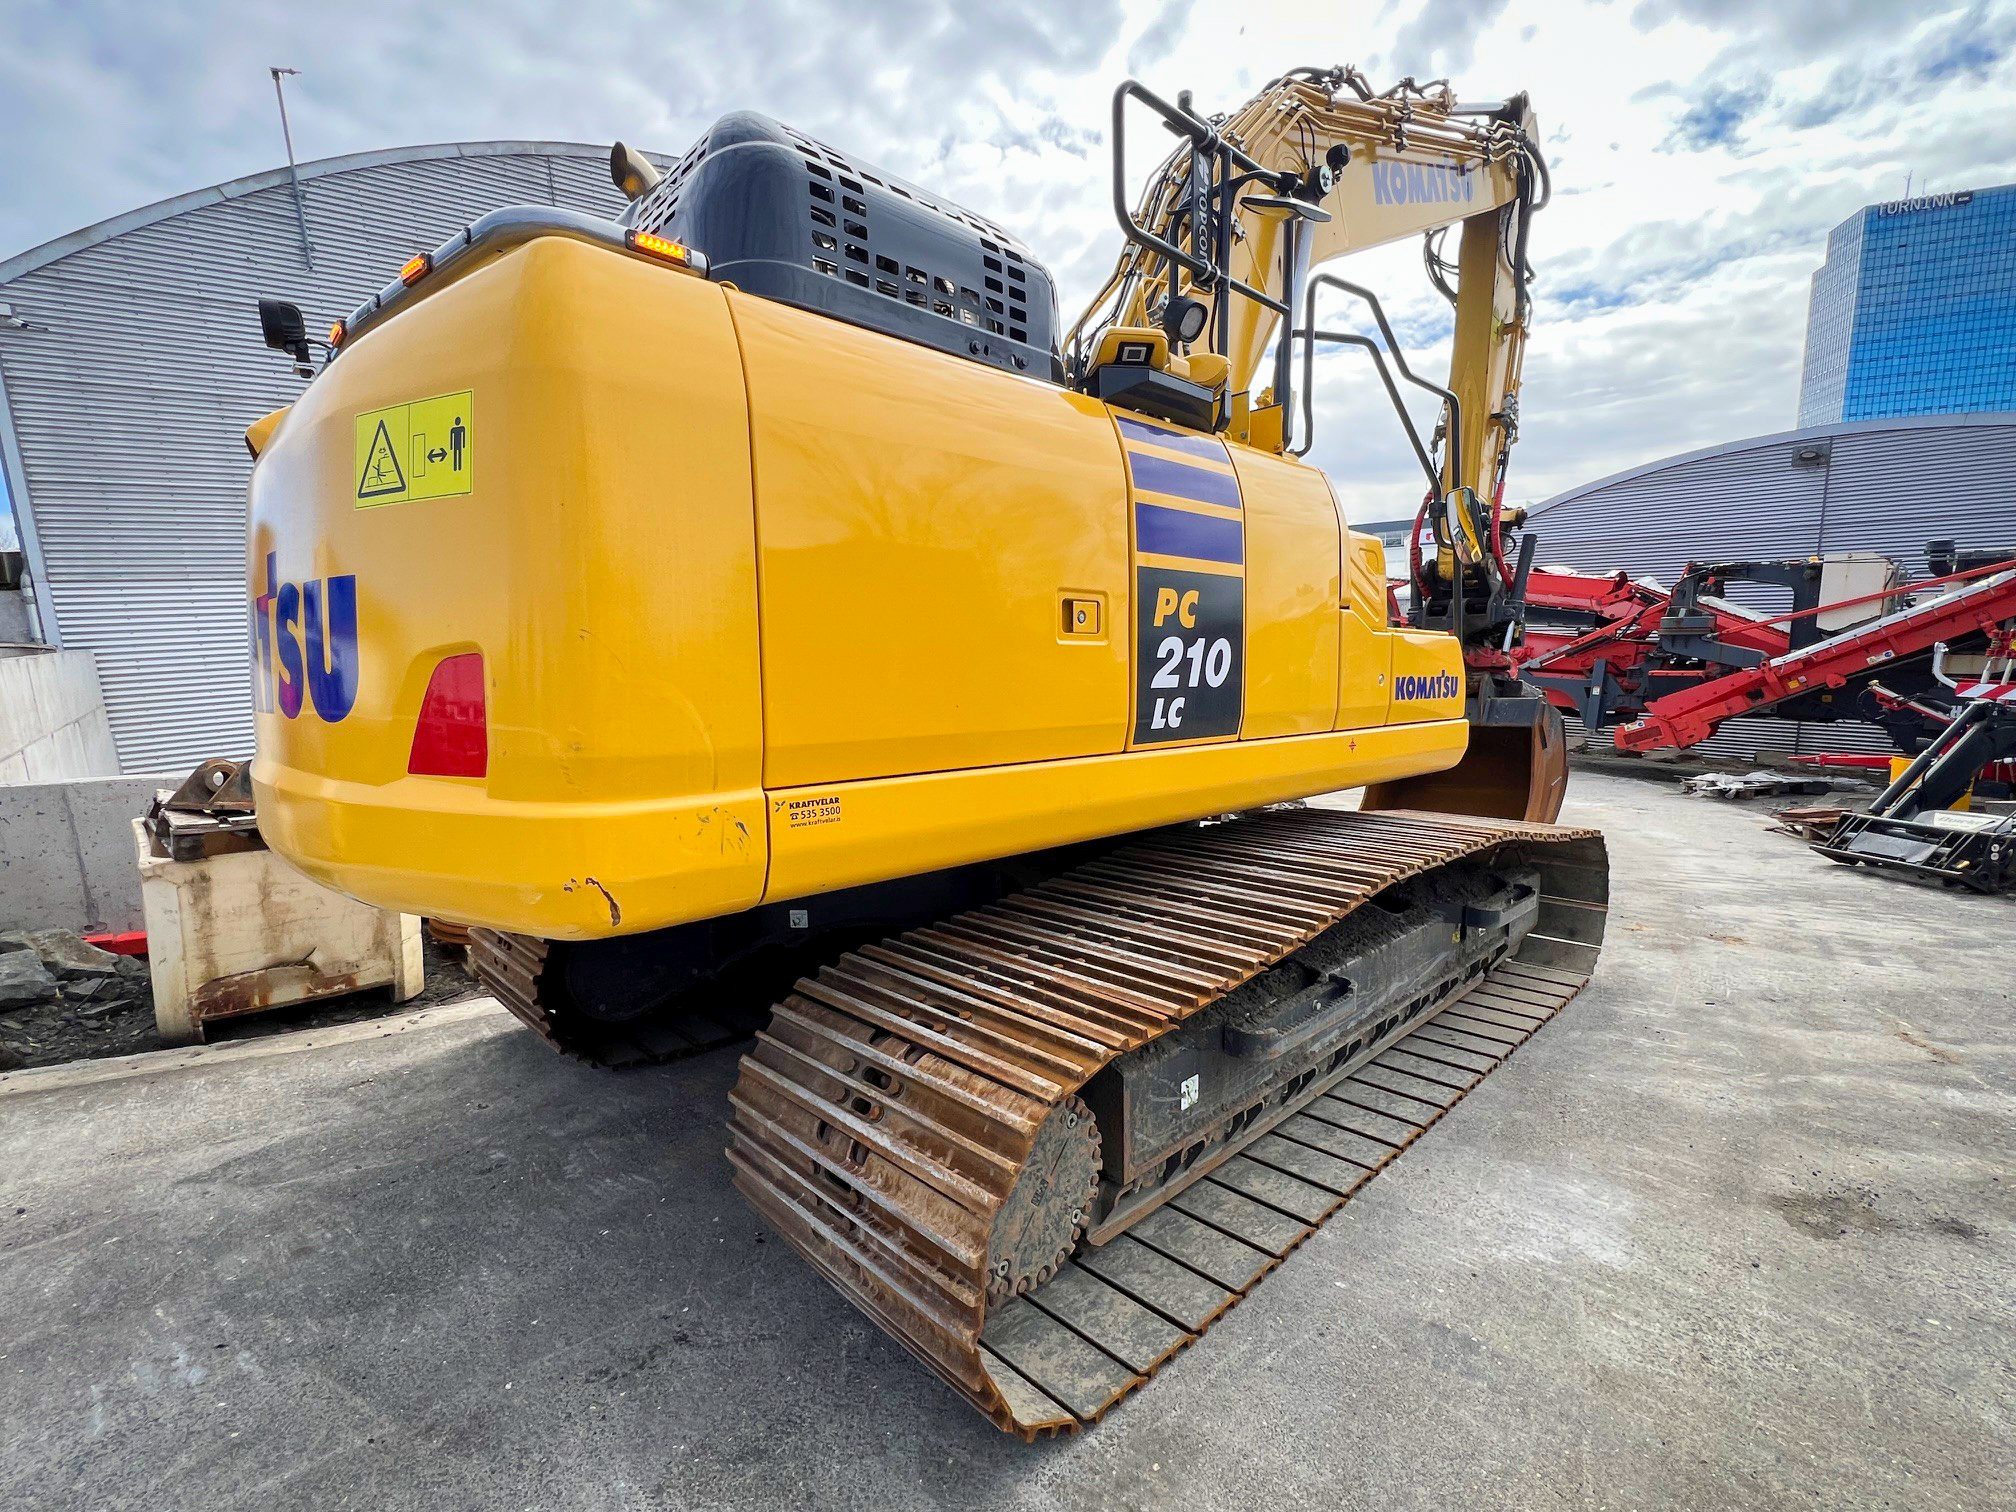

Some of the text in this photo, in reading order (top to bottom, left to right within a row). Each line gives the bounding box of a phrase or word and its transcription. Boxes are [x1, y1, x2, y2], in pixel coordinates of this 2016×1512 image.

[1371, 157, 1474, 205] KOMATSU
[1153, 587, 1200, 629] PC
[1150, 636, 1232, 688] 210
[1395, 669, 1459, 700] KOMATSU
[1151, 697, 1186, 730] LC
[801, 806, 841, 819] 535 3500
